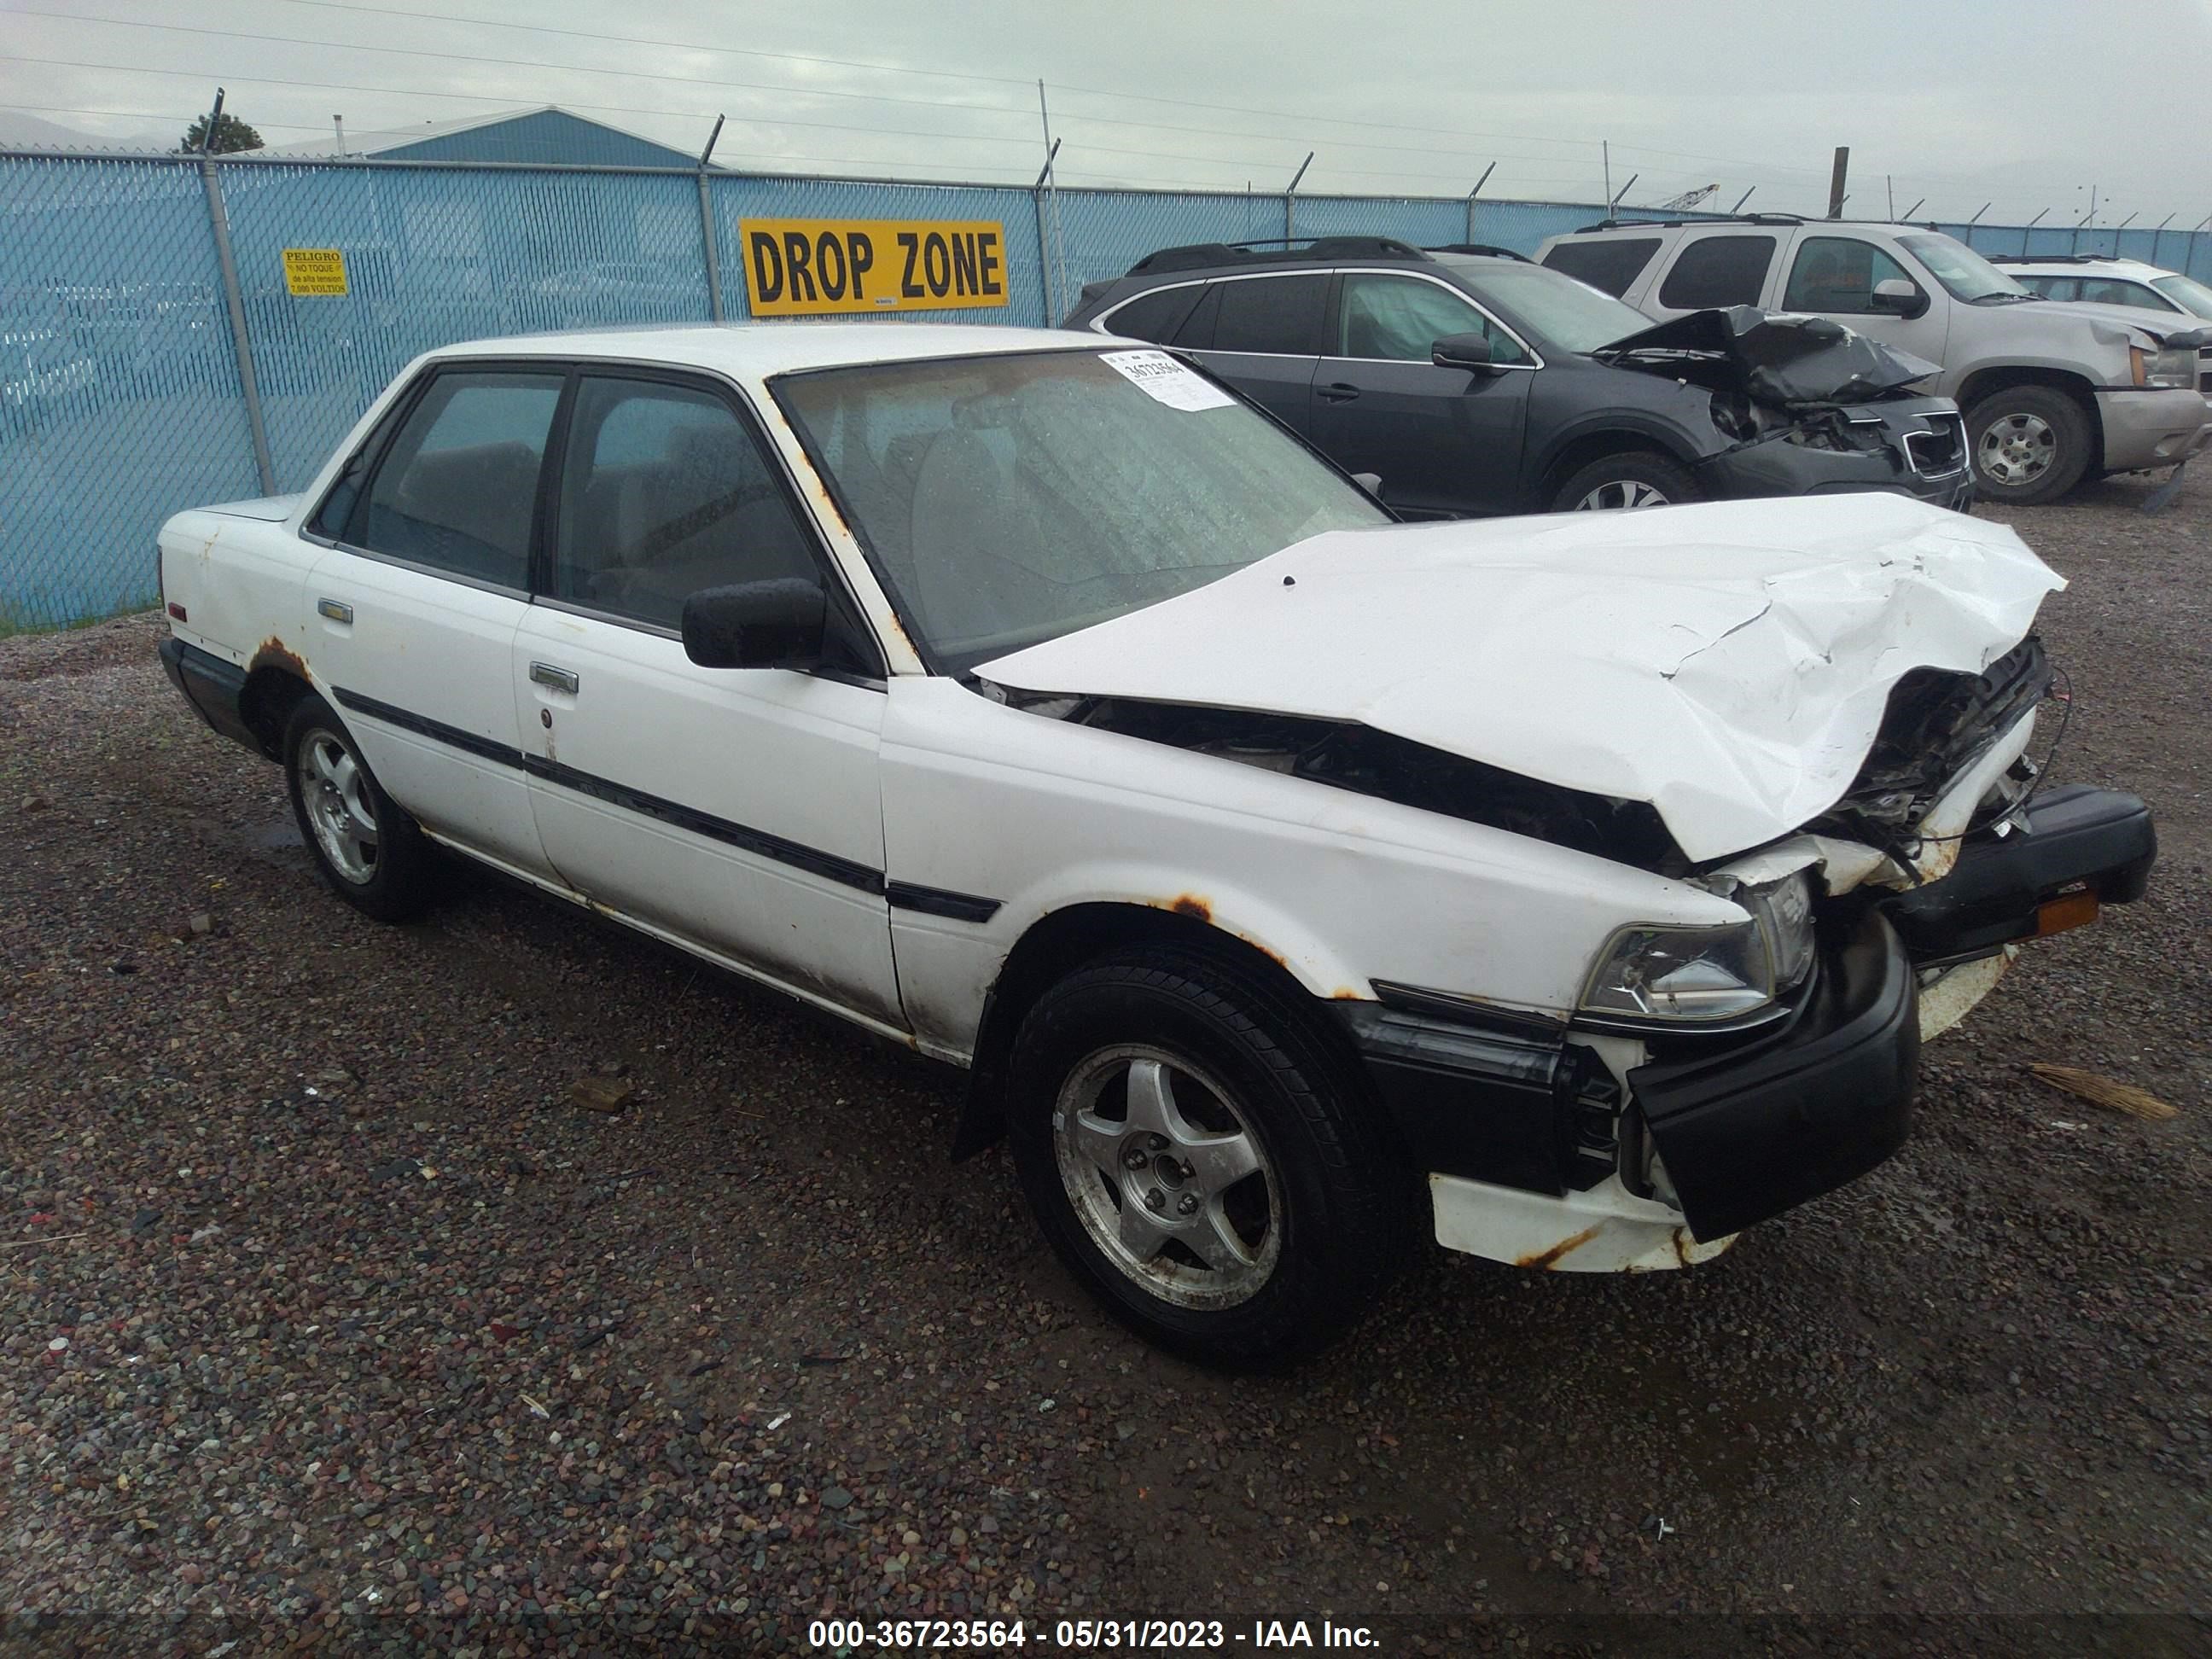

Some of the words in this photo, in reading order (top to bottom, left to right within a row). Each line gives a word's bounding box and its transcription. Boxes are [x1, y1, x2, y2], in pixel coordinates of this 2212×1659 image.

[286, 252, 341, 261] PELIGRO
[296, 264, 307, 272] NO
[309, 264, 334, 272] TOQUE
[750, 231, 874, 303] DROP
[897, 231, 1002, 299] ZONE
[293, 274, 301, 282] de
[303, 274, 316, 282] alta
[311, 284, 346, 294] VOLTIOS
[1125, 362, 1185, 378] 36723564
